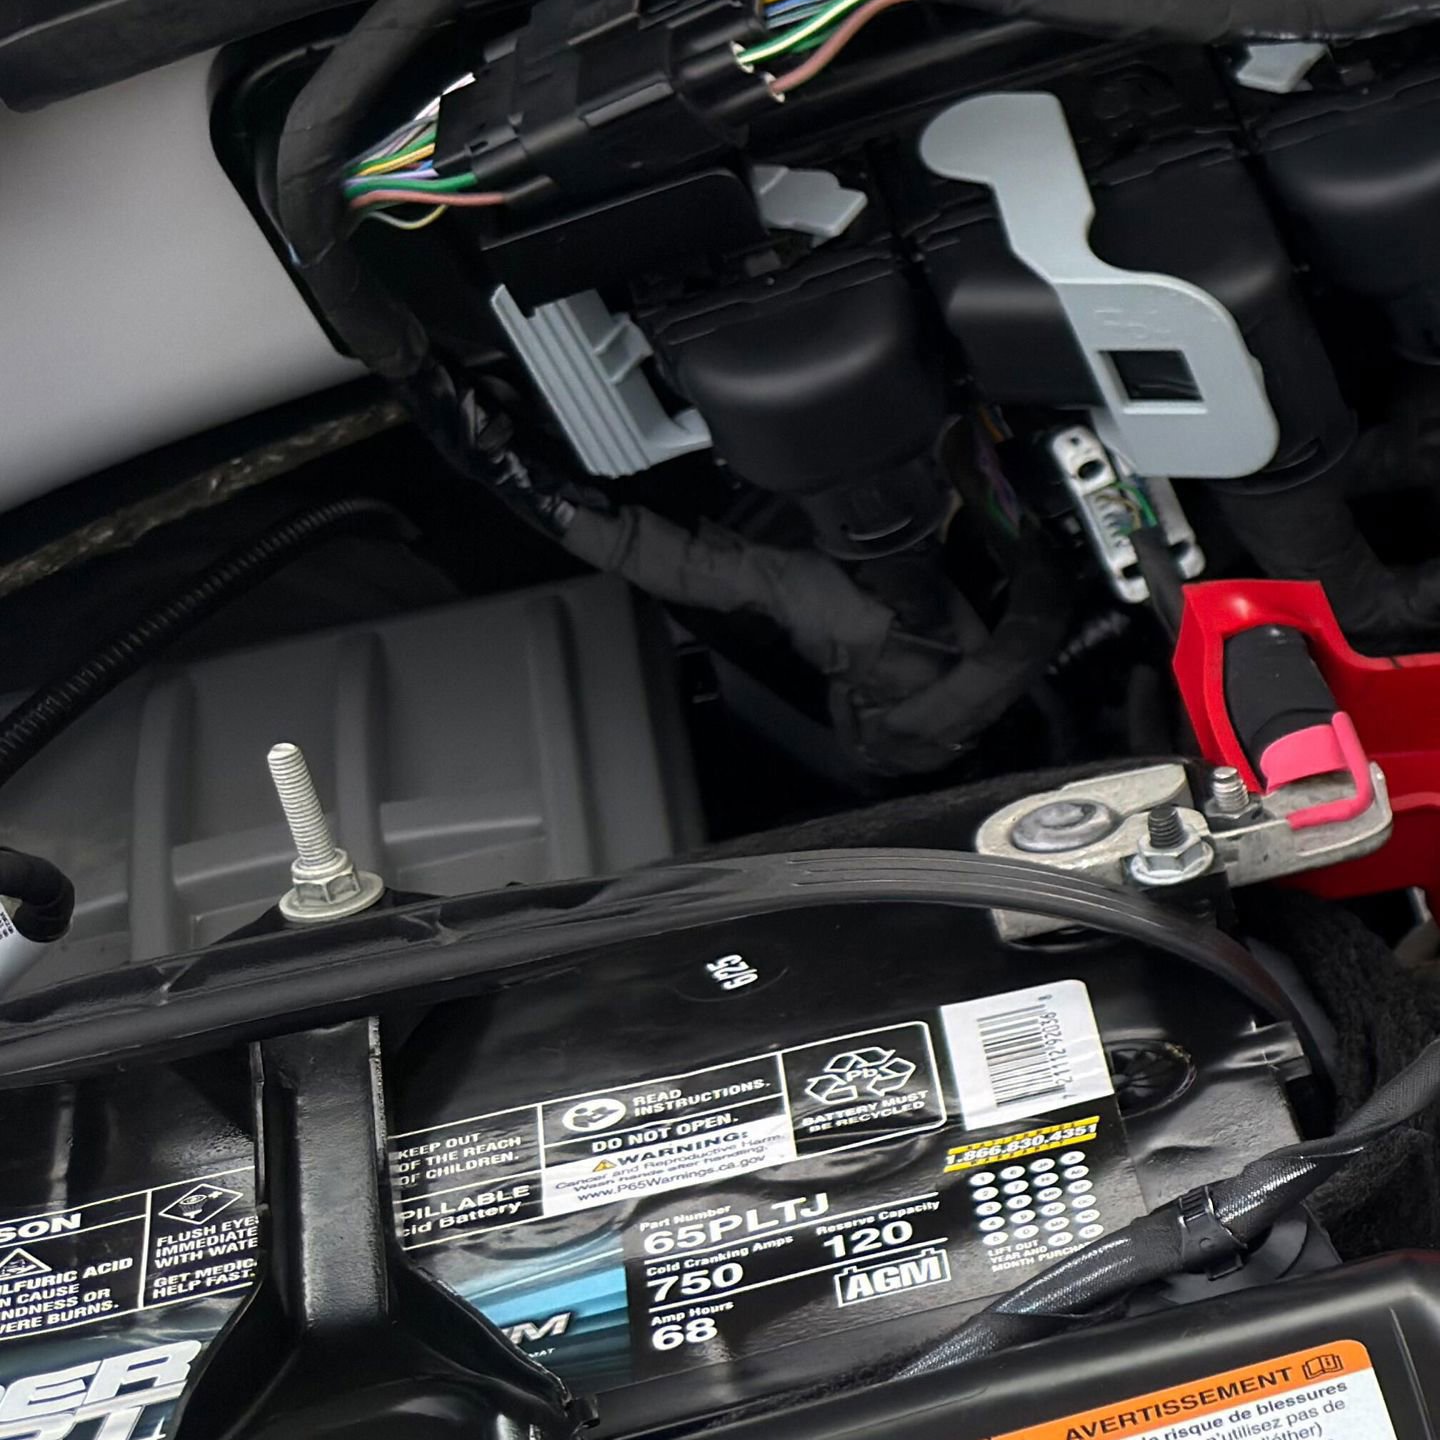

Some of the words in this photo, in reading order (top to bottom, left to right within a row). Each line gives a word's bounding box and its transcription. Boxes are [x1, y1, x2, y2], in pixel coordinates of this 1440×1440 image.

[705, 953, 758, 991] 6/25
[845, 1068, 878, 1082] Pb
[632, 1089, 682, 1107] READ
[633, 1078, 771, 1117] INSTRUCTIONS.
[800, 1102, 878, 1128] BATTERY
[881, 1089, 929, 1108] MUST
[808, 1122, 832, 1133] BE
[835, 1100, 926, 1127] RECYCLED
[444, 1132, 481, 1149] OUT
[591, 1137, 622, 1153] DO
[627, 1126, 672, 1146] NOT
[676, 1112, 739, 1136] OPEN.
[425, 1150, 458, 1166] THE
[463, 1136, 522, 1158] REACH
[614, 1131, 748, 1168] WARNING:
[425, 1151, 523, 1180] CHILDREN.
[439, 1201, 525, 1229] Battery
[638, 1217, 670, 1233] Part
[673, 1205, 732, 1224] Number
[643, 1192, 829, 1255] 65PLTJ
[815, 1215, 875, 1236] Reserve
[878, 1200, 940, 1221] Capacity
[156, 1224, 217, 1248] FLUSH
[822, 1220, 913, 1258] 120
[82, 1257, 134, 1279] ACID
[154, 1249, 204, 1269] WITH
[646, 1261, 681, 1277] Cold
[683, 1247, 749, 1269] Cranking
[752, 1235, 794, 1253] Amps
[152, 1279, 202, 1299] HELP
[153, 1272, 192, 1288] GET
[646, 1262, 744, 1303] 750
[849, 1256, 942, 1300] AGM
[16, 1283, 80, 1304] CAUSE
[82, 1288, 111, 1303] OR
[46, 1299, 120, 1325] BURNS.
[650, 1312, 686, 1327] Amp
[688, 1301, 735, 1318] Hours
[651, 1317, 718, 1351] 68
[1227, 1409, 1252, 1424] de
[1255, 1382, 1348, 1416] blessures
[1285, 1407, 1320, 1428] pas
[1322, 1399, 1346, 1414] de
